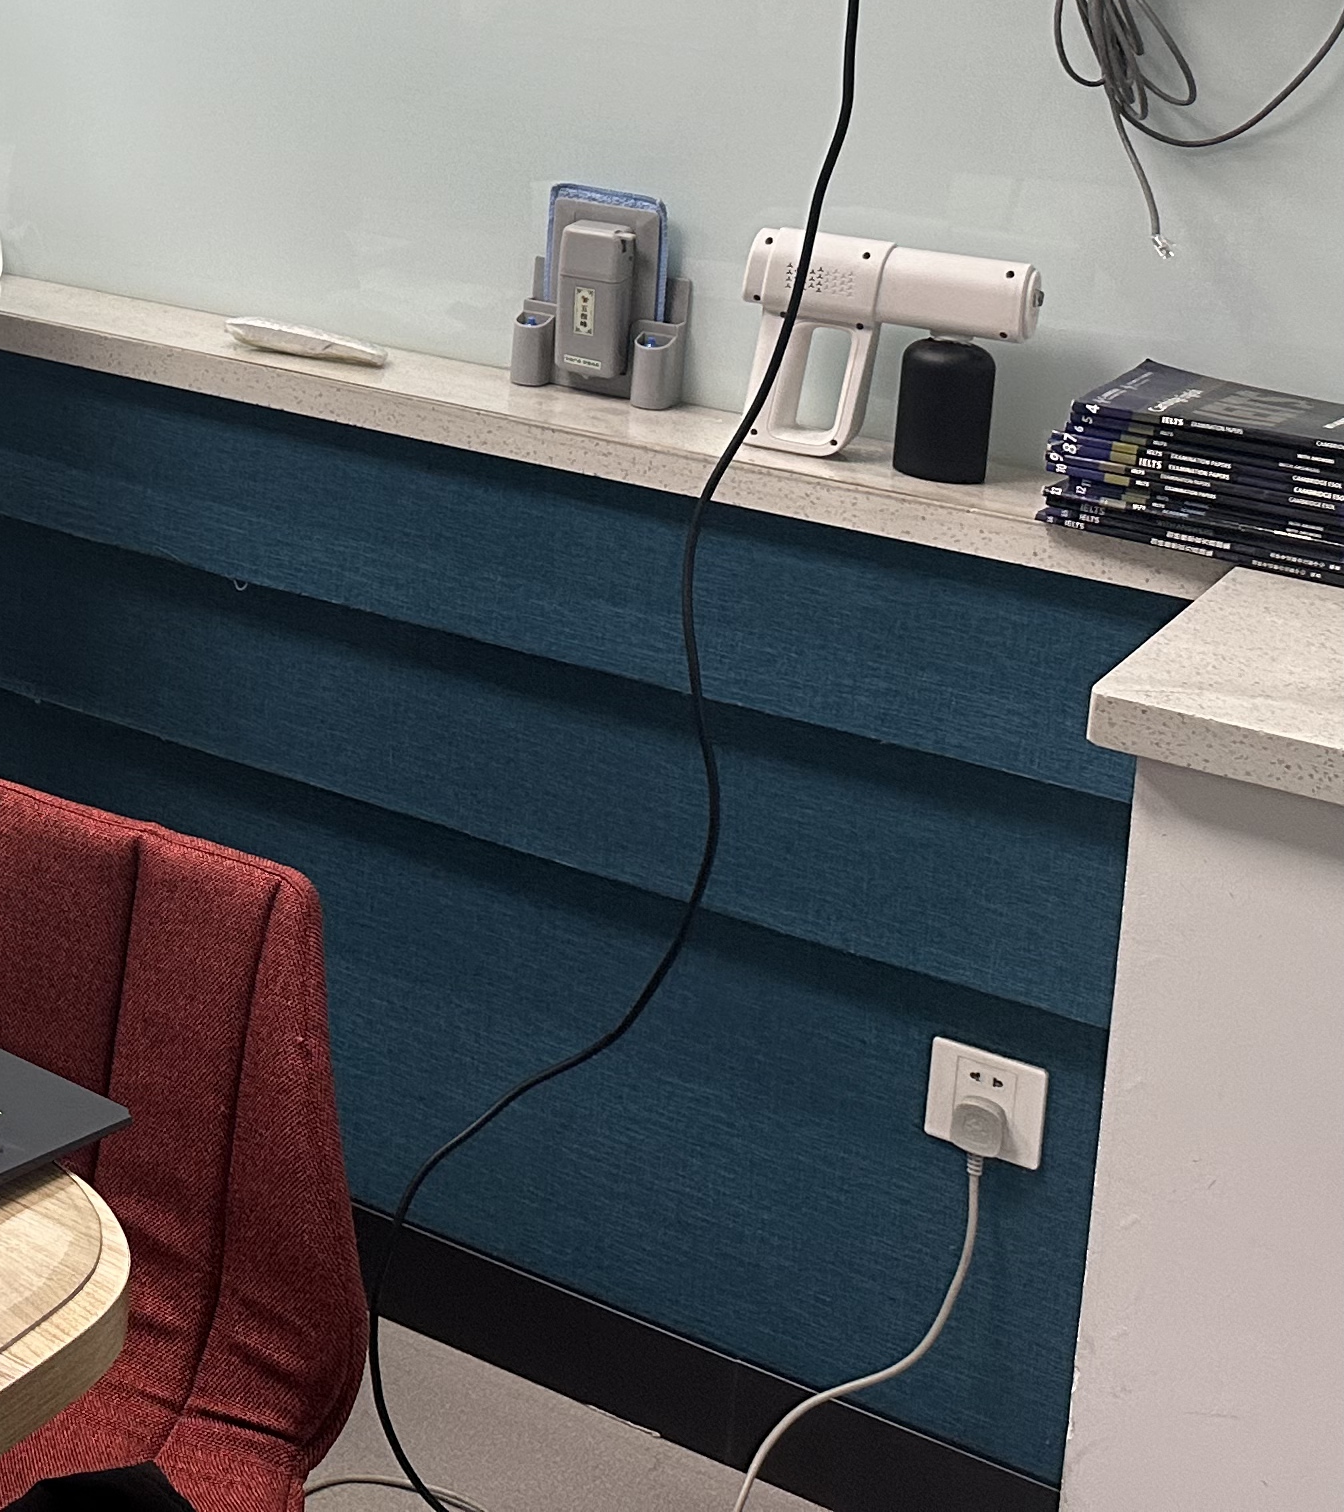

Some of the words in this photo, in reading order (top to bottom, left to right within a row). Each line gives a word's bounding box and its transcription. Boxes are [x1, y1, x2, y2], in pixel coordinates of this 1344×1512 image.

[1081, 415, 1093, 424] 5
[1085, 404, 1100, 414] 4
[1161, 416, 1184, 426] IELTS
[1074, 425, 1084, 433] 6
[1063, 432, 1078, 443] 7
[1049, 452, 1064, 462] 9
[1062, 443, 1077, 455] 8
[1138, 457, 1163, 470] IELTS
[1055, 463, 1068, 474] 10
